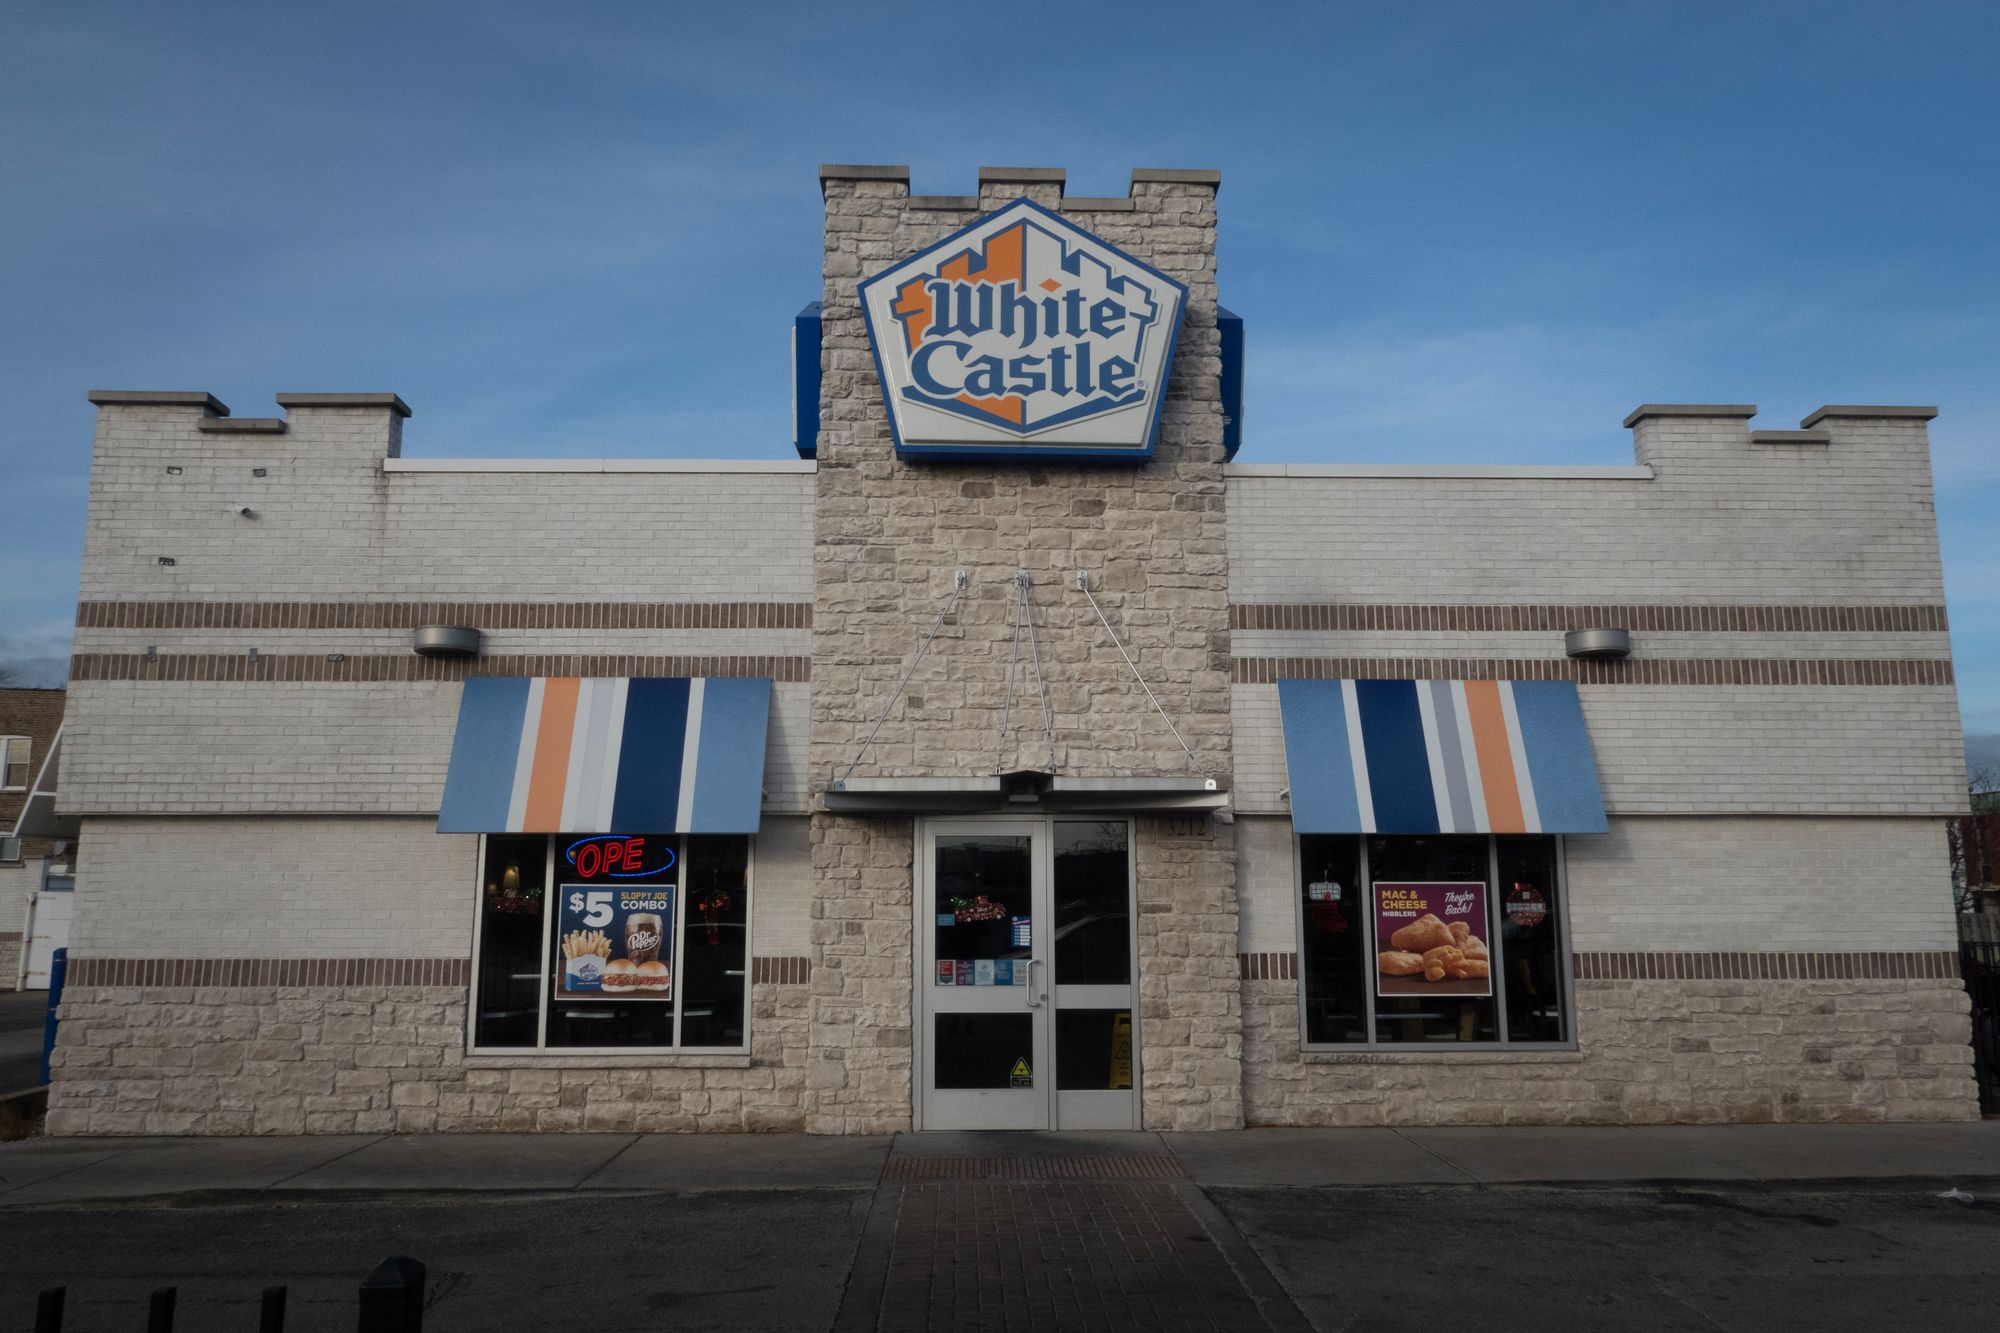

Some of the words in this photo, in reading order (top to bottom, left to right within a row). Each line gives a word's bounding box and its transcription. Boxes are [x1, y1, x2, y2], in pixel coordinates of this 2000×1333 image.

[924, 279, 1126, 349] White
[911, 340, 1136, 397] Castle
[1167, 817, 1206, 836] 3212
[621, 892, 652, 900] SLOPPY
[653, 892, 668, 900] JOE
[1382, 890, 1407, 900] MAC
[1410, 890, 1418, 900] &
[1445, 890, 1475, 906] They're
[569, 891, 614, 928] $5
[620, 900, 667, 910] COMBO
[1382, 900, 1428, 910] CHEESE
[1445, 902, 1473, 915] Back!
[630, 934, 658, 950] Pepper
[639, 931, 651, 941] Dr
